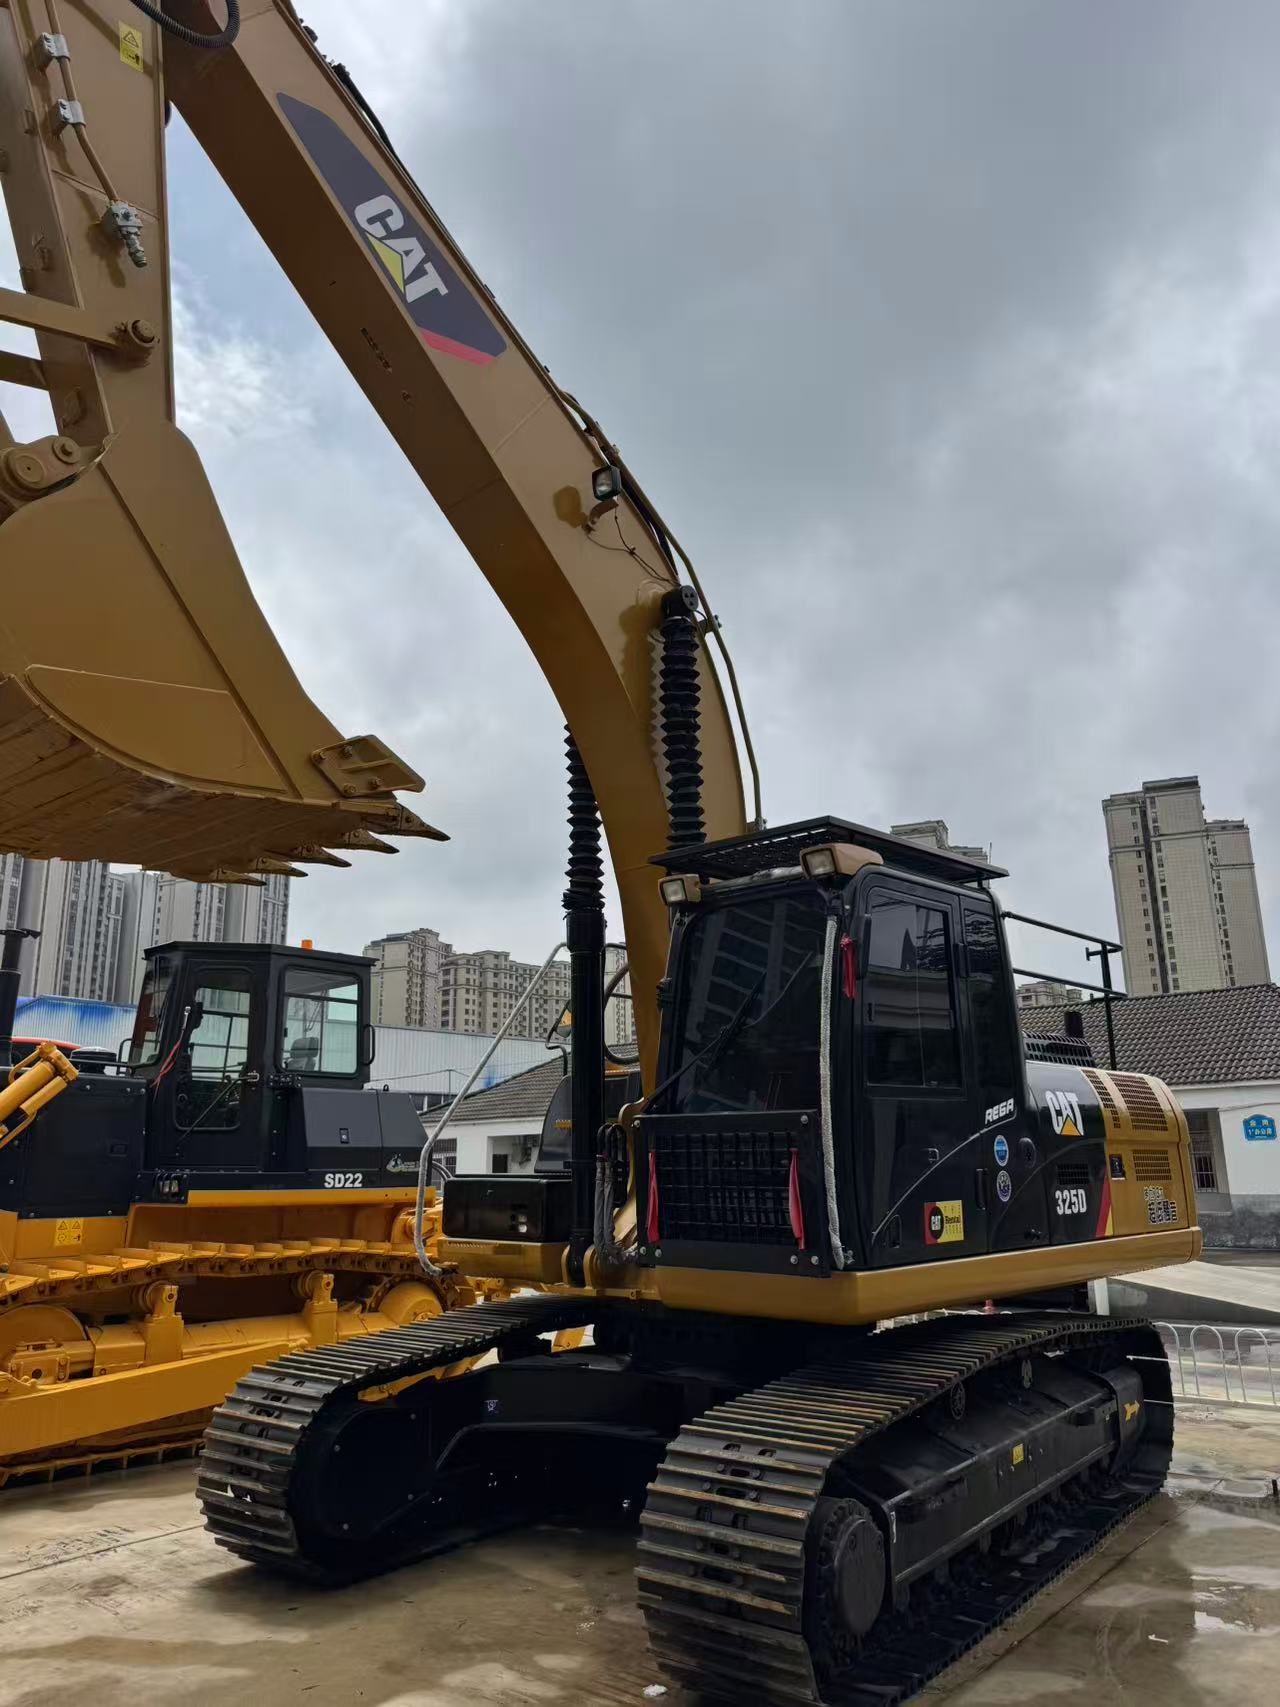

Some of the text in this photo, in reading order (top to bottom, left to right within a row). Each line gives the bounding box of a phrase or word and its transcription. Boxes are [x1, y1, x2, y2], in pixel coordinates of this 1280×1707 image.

[354, 194, 449, 304] CAT
[1044, 1090, 1085, 1136] CAT
[324, 1172, 363, 1188] SD22
[1055, 1188, 1088, 1215] 325D
